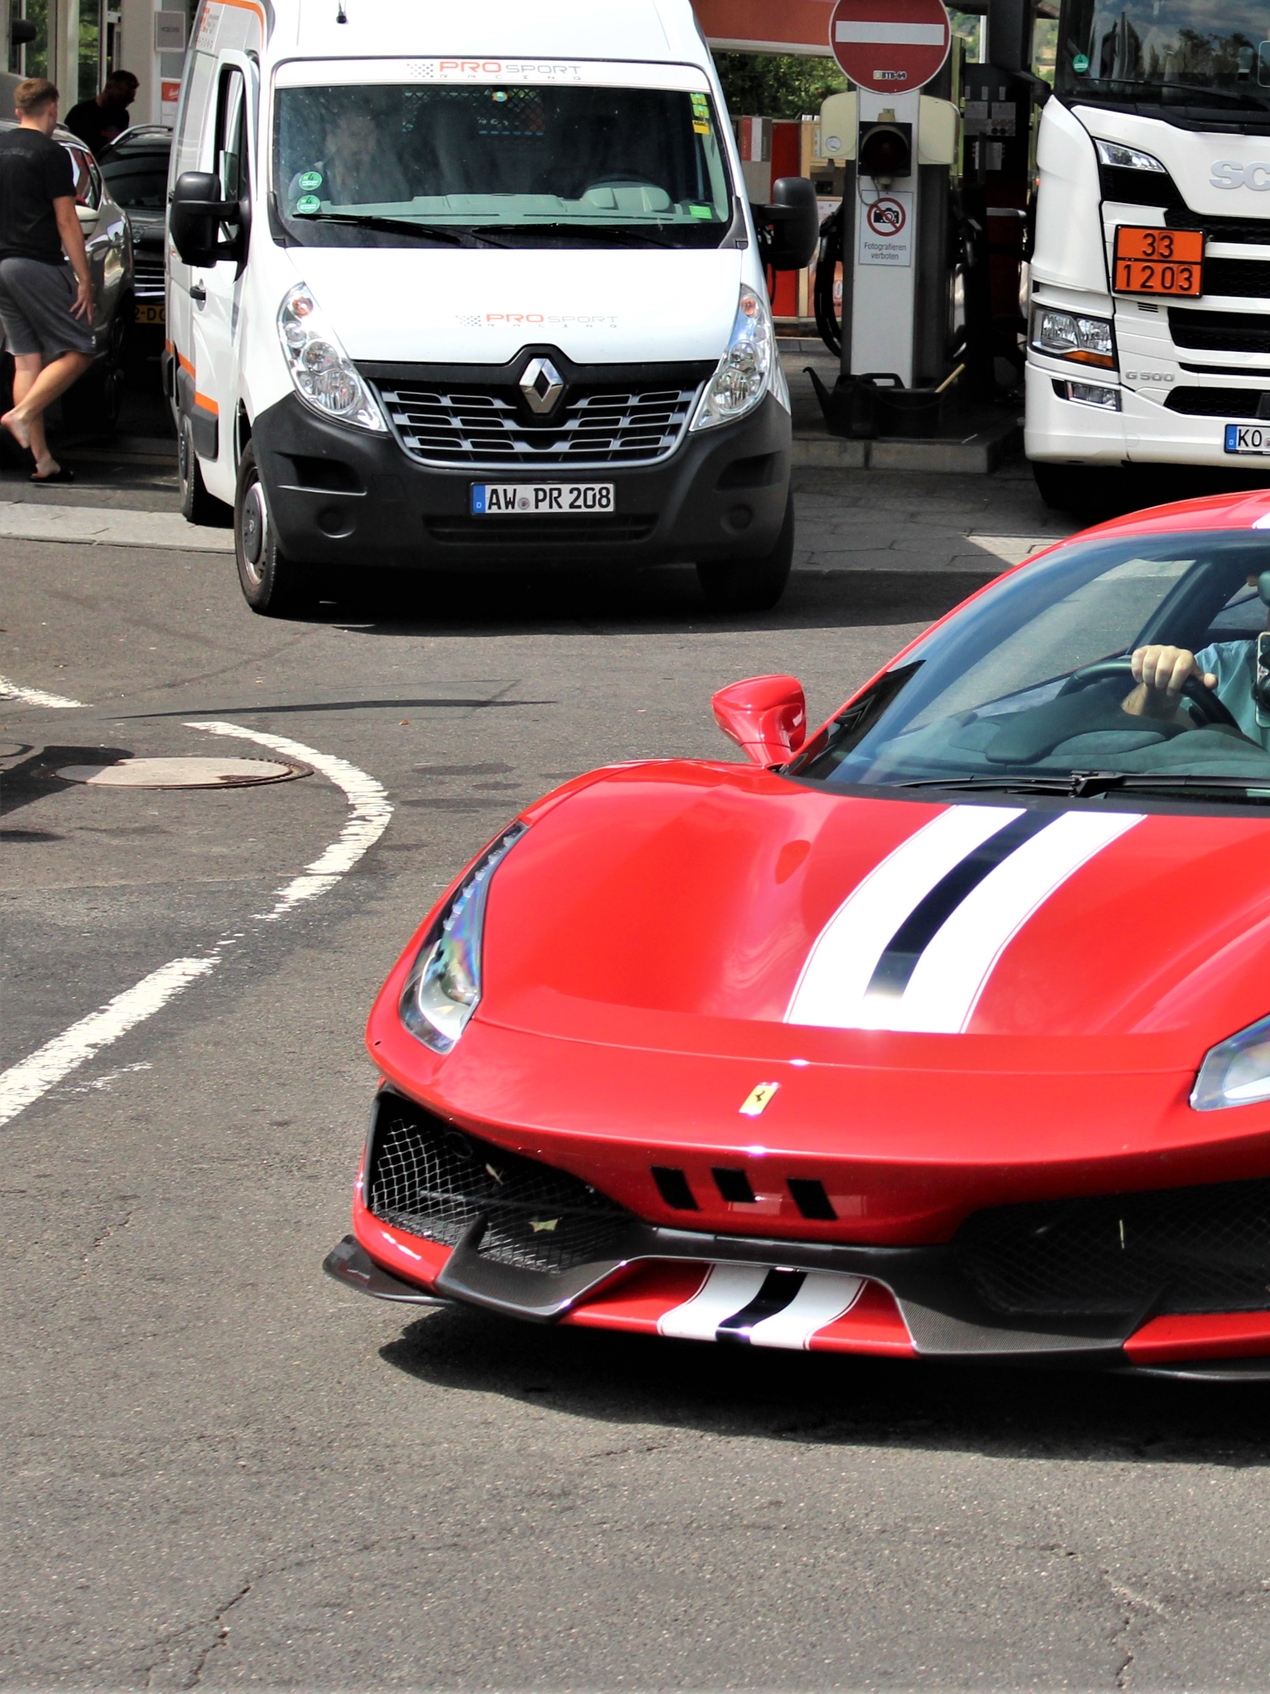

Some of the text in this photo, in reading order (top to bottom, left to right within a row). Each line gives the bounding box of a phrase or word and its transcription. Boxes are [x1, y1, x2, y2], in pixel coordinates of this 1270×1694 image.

[440, 61, 582, 75] PRO SPORT
[864, 242, 907, 251] Fotografieren
[1141, 232, 1174, 259] 33
[871, 252, 900, 260] verboten
[1123, 263, 1193, 291] 1203
[486, 314, 545, 323] PRO
[1125, 370, 1175, 382] G 500
[1238, 429, 1262, 447] KO
[488, 488, 517, 510] AW
[533, 487, 563, 509] PR
[568, 486, 611, 509] 208
